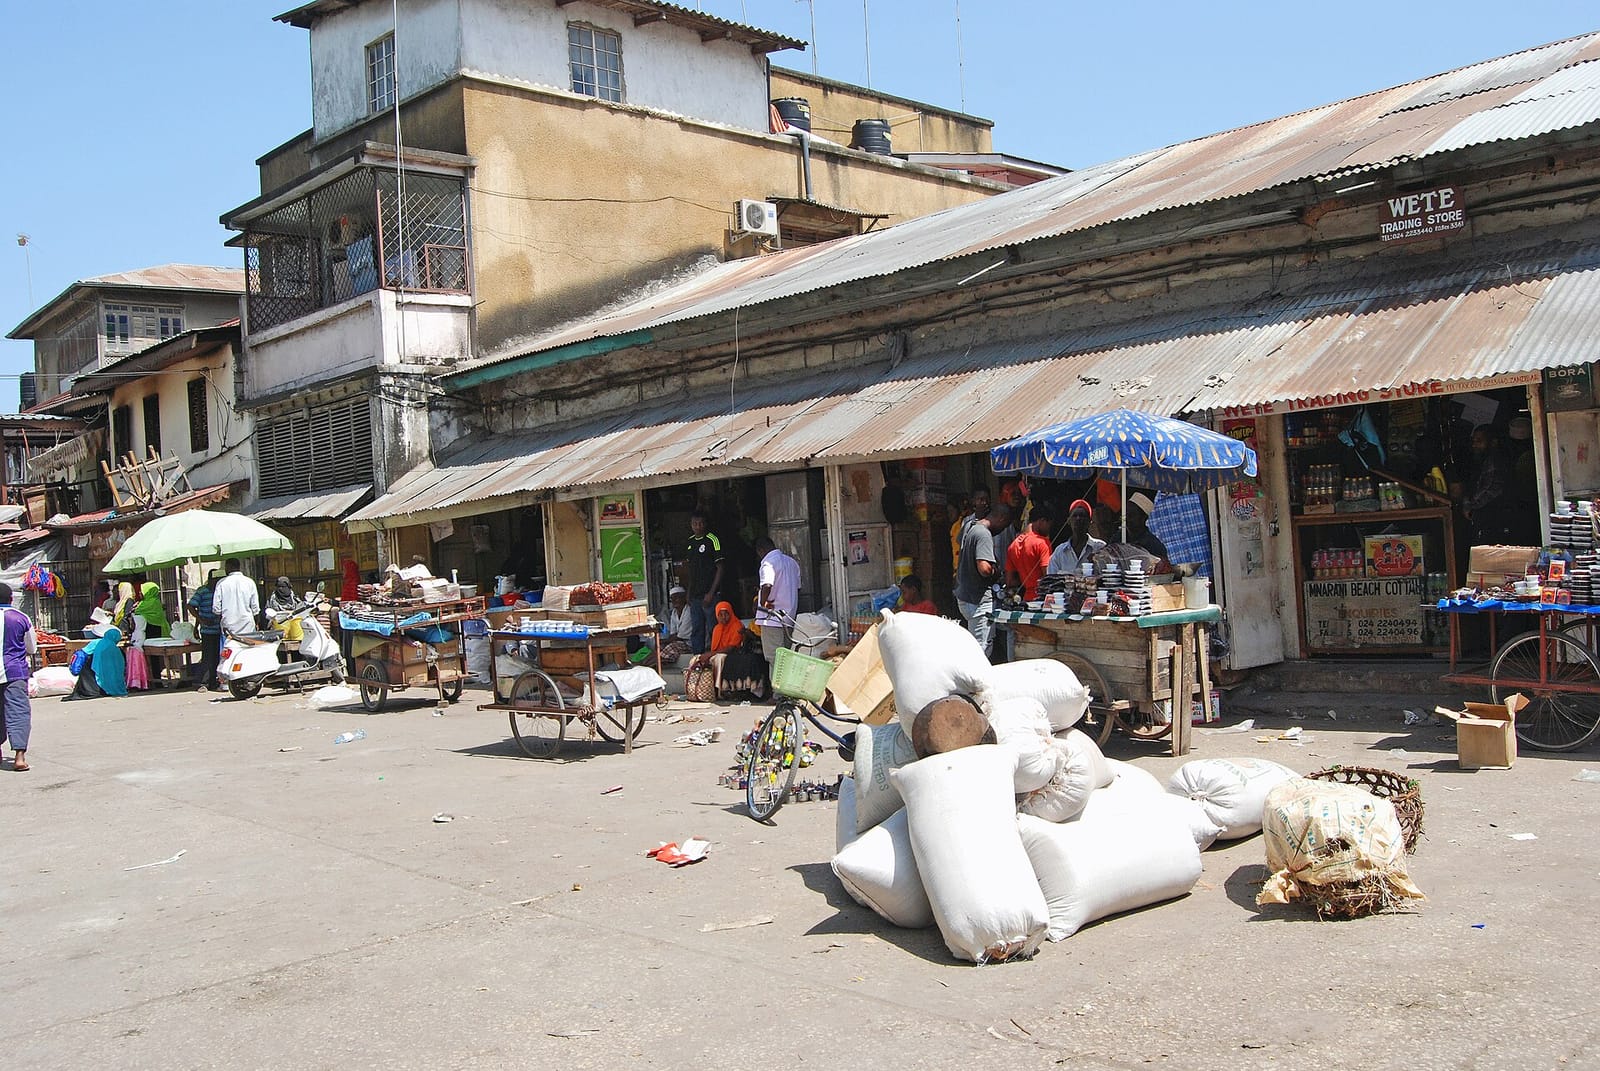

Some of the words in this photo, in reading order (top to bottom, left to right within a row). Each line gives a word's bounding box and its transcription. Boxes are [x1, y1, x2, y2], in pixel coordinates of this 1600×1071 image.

[1388, 188, 1455, 218] WETE
[1380, 218, 1422, 234] TRADING
[1427, 209, 1462, 225] STORE
[1548, 367, 1586, 378] BORA
[1287, 390, 1369, 411] TRADING
[1089, 446, 1107, 464] RANI
[1309, 583, 1348, 598] MNARANI
[1351, 581, 1381, 597] BEACH
[874, 763, 889, 791] FEEDS
